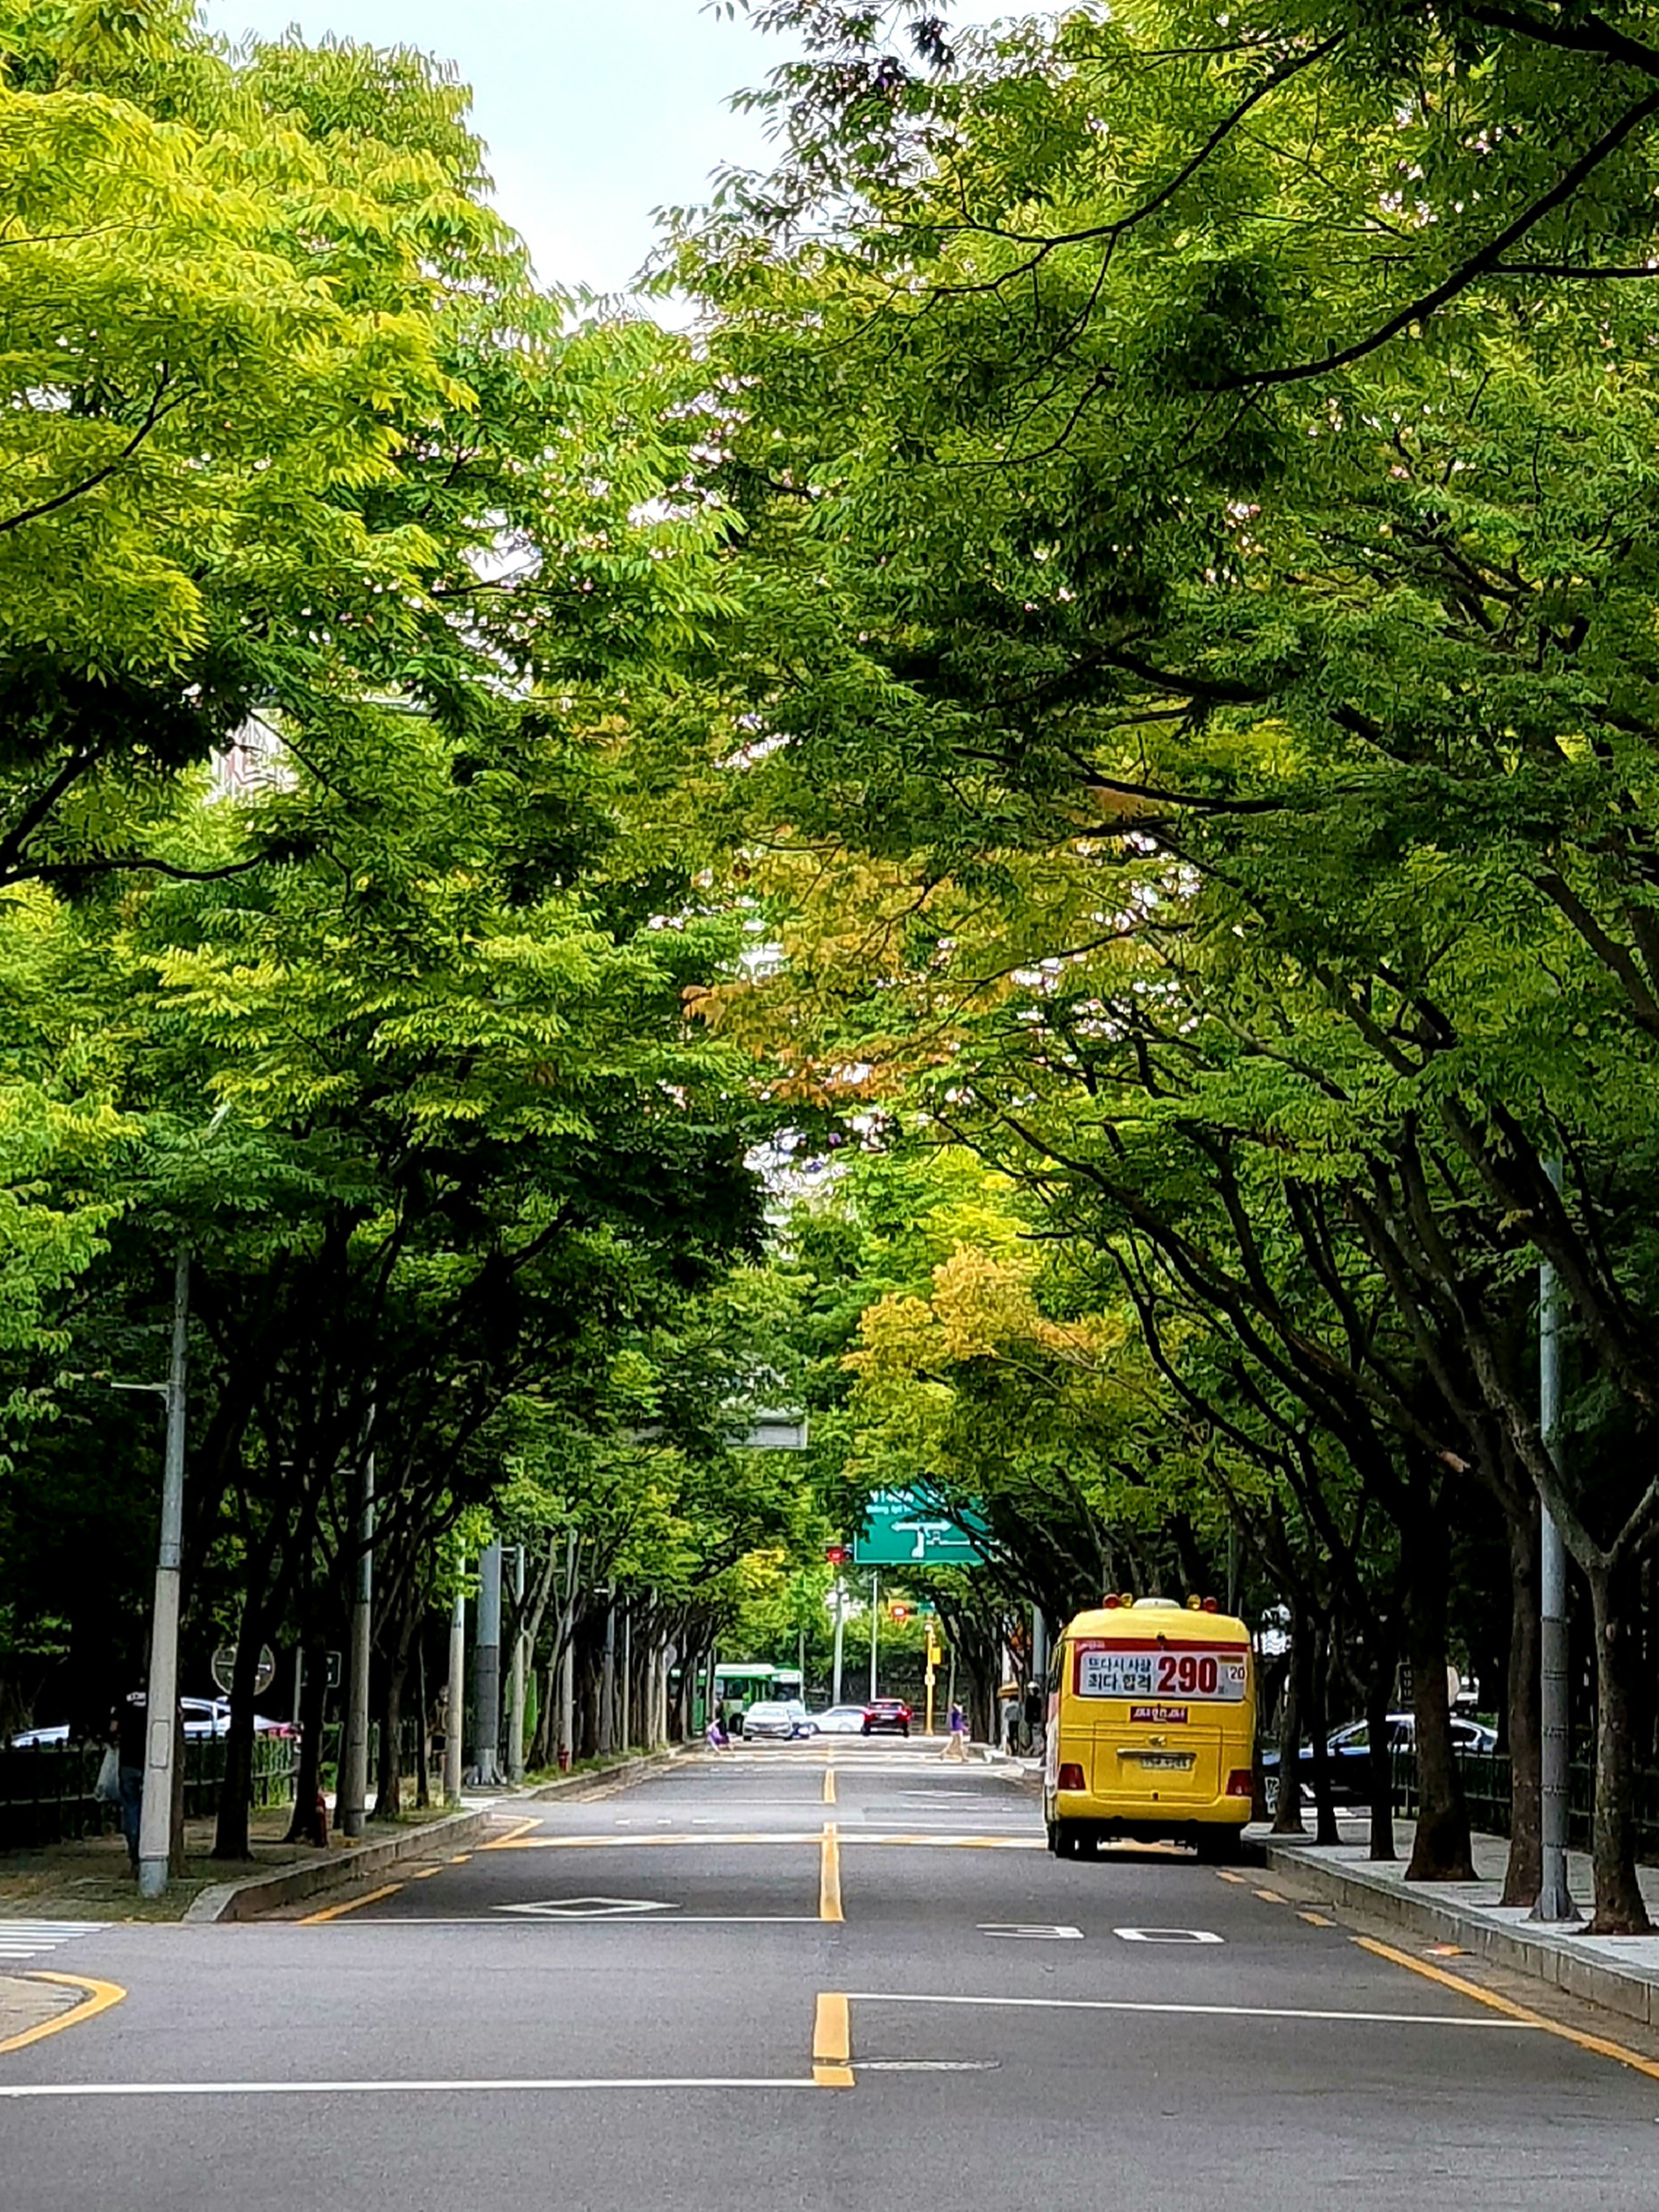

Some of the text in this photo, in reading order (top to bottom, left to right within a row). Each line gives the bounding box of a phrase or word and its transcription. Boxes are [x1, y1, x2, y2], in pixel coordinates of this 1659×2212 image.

[1122, 1673, 1152, 1692] 합격
[1157, 1656, 1218, 1694] 290
[975, 1922, 1226, 1944] 30
